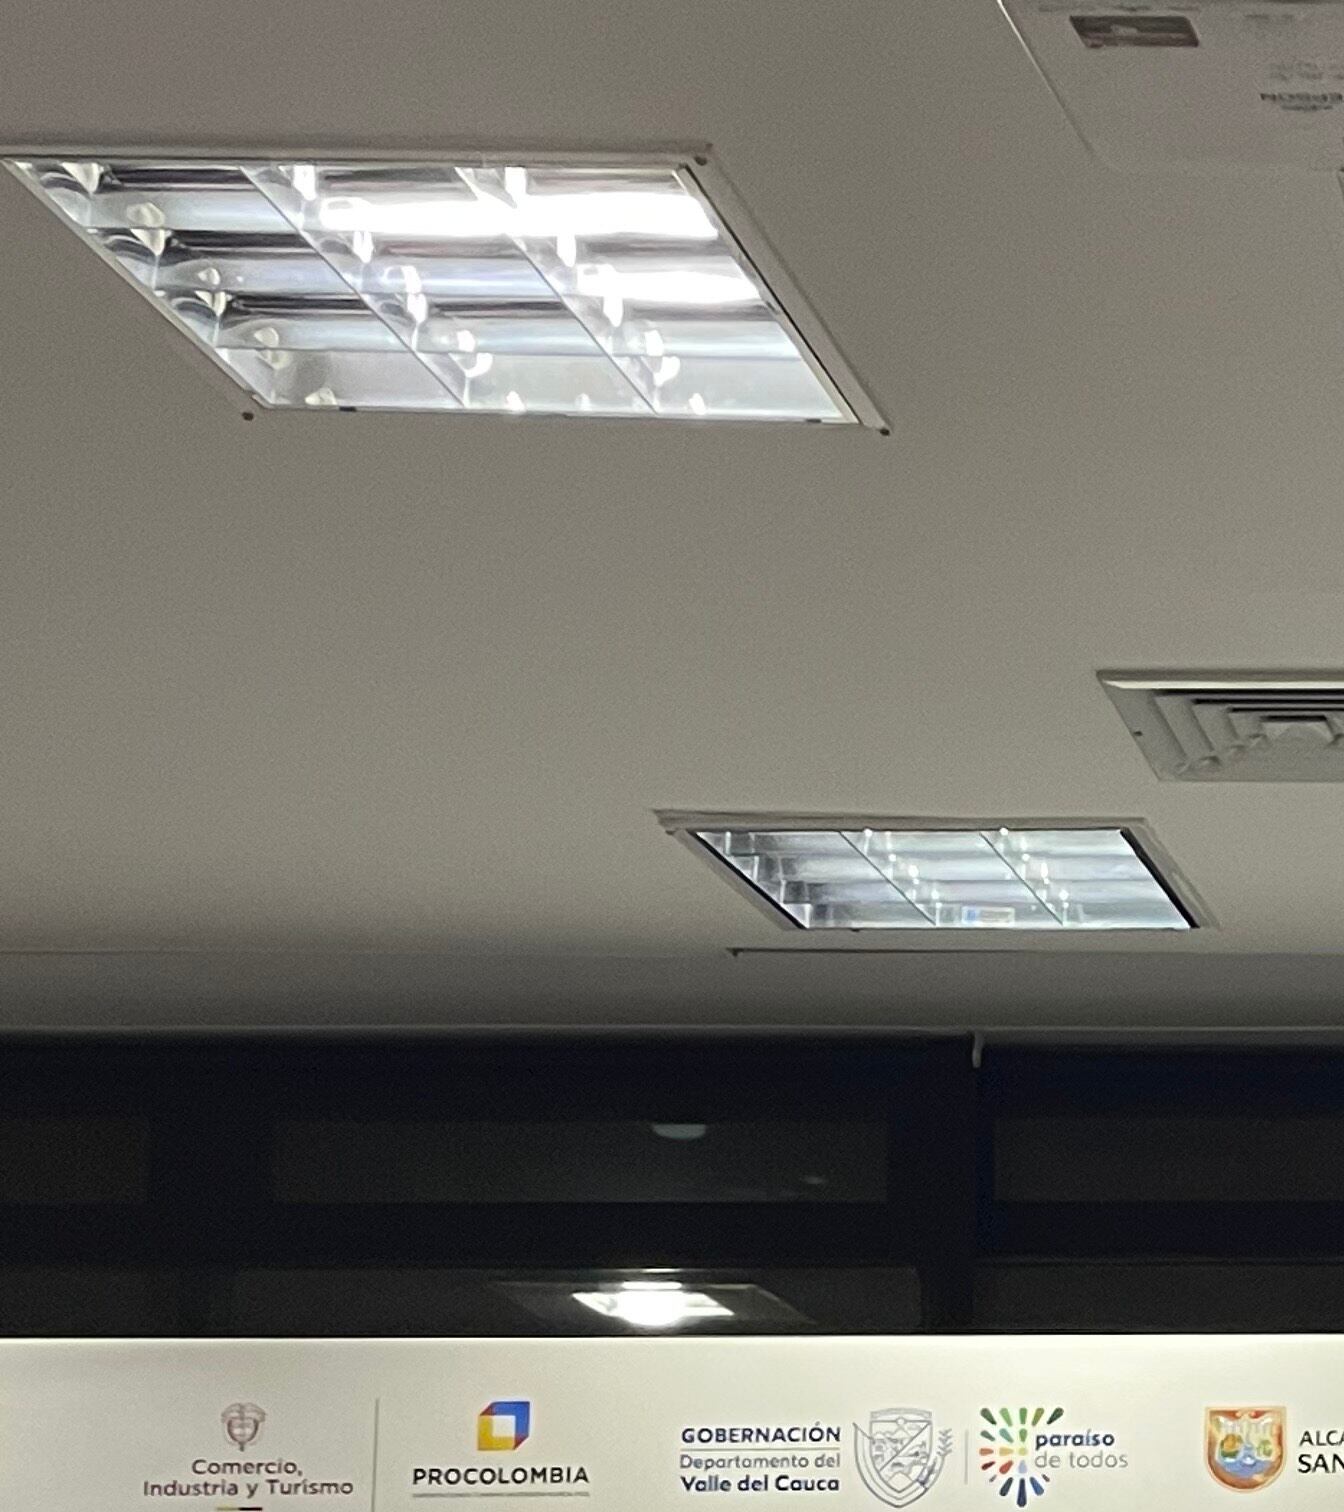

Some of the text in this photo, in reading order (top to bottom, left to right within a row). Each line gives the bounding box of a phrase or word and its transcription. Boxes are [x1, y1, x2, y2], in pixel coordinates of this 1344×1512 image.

[681, 1421, 841, 1444] GOBERNACIÓN
[1035, 1433, 1115, 1451] paraíso
[191, 1458, 303, 1477] Comercio,
[412, 1466, 590, 1486] PROCOLOMBIA
[143, 1478, 354, 1500] Industria y Turismo
[680, 1474, 840, 1492] Valle del Cauca
